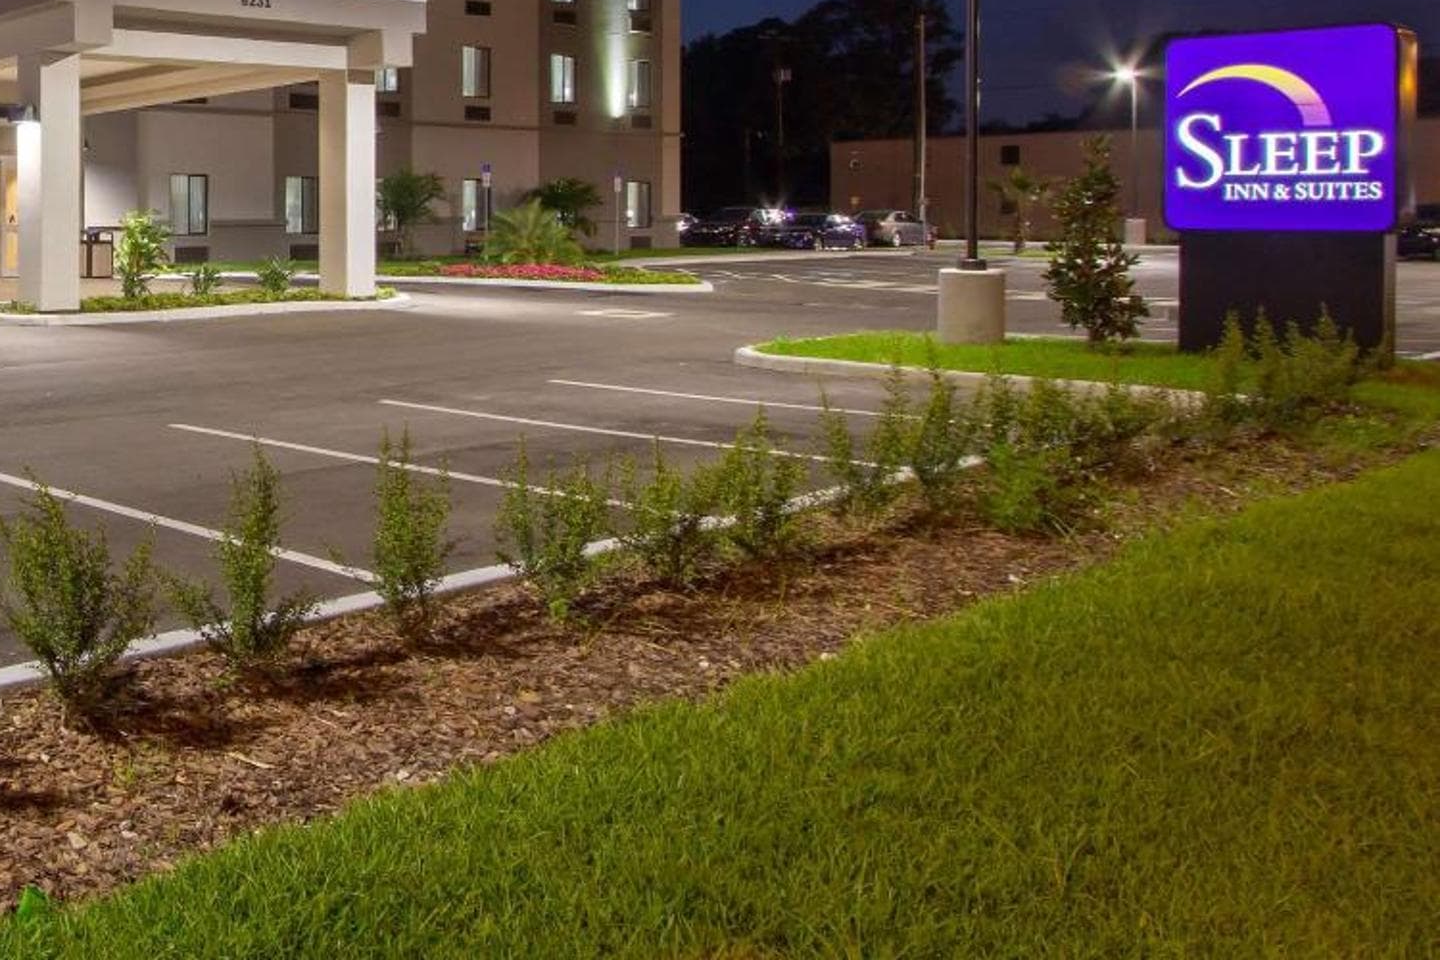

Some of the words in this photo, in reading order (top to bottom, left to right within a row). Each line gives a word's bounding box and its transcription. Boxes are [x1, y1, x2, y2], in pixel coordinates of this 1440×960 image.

[1176, 113, 1384, 189] SLEEP
[1224, 183, 1269, 201] INN
[1273, 183, 1291, 200] &
[1294, 181, 1383, 200] SUITES
